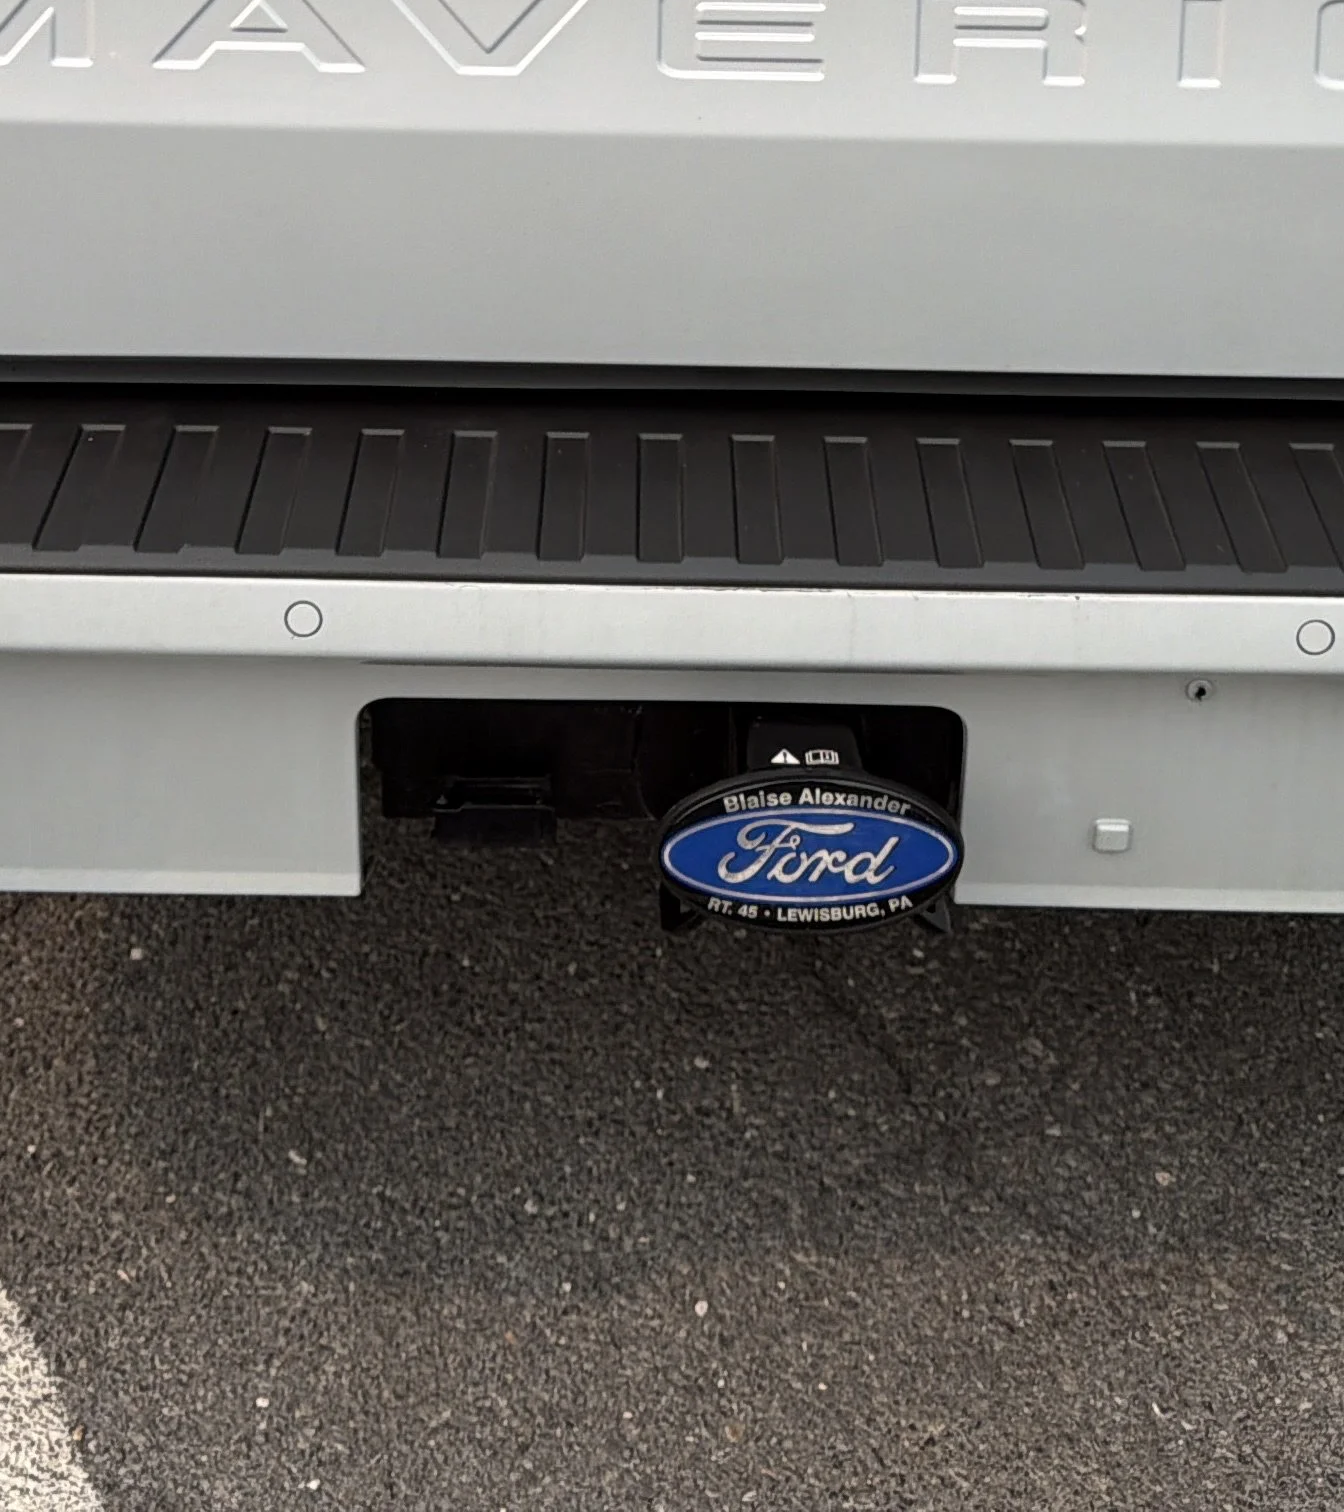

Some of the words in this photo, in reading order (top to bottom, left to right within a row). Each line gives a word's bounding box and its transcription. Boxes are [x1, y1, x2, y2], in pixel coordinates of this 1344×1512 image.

[722, 789, 792, 813] Blaise
[799, 788, 911, 816] Alexander
[717, 818, 900, 885] Ford
[707, 896, 733, 915] RT.
[737, 903, 758, 919] 45
[776, 904, 886, 922] LEWISBURG,
[888, 895, 913, 912] PA
